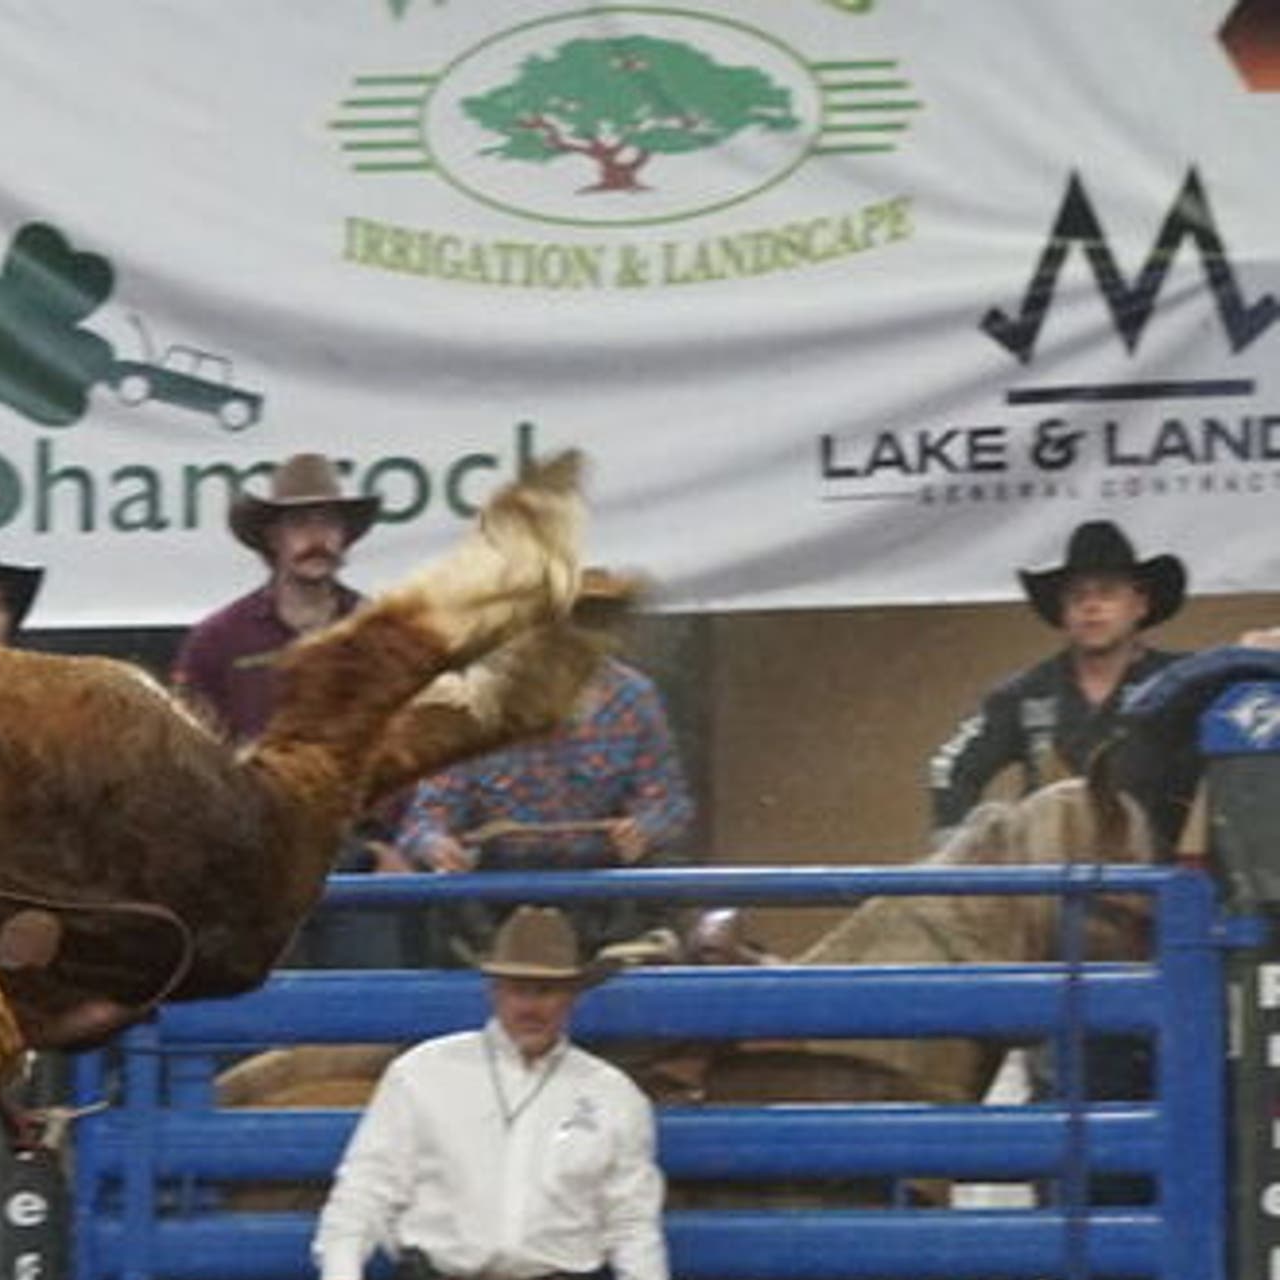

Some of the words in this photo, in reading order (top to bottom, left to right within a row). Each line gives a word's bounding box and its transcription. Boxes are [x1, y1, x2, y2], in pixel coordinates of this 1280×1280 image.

[343, 214, 605, 290] IRRIGATION
[614, 240, 651, 288] &
[661, 199, 915, 286] LANDSCAPE
[820, 427, 1010, 479] LAKE
[1030, 418, 1086, 471] &
